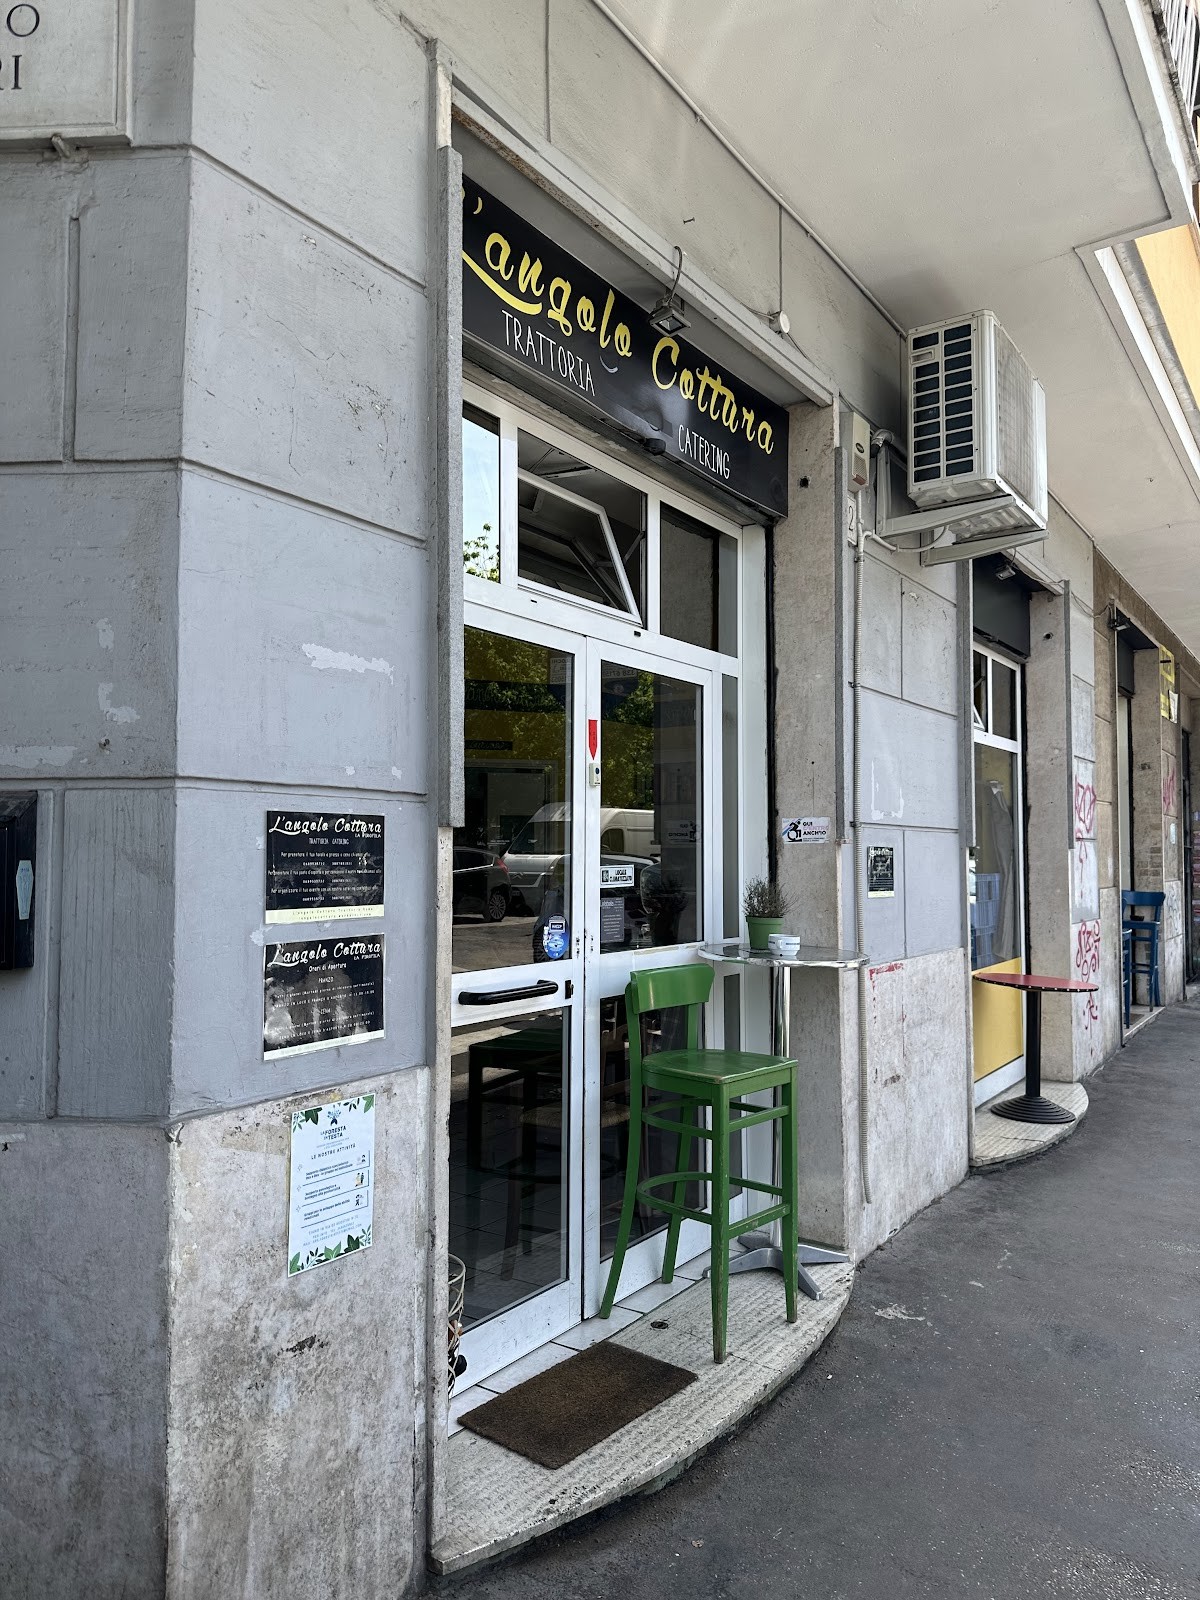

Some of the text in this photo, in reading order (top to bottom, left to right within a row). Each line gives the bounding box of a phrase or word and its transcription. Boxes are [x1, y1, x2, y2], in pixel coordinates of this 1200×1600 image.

[0, 55, 22, 90] I
[502, 309, 596, 397] TRATTORIA
[652, 337, 774, 454] Cottura
[678, 424, 731, 479] CATERING
[268, 816, 382, 835] L'angolo Cottura
[267, 942, 381, 967] L'angolo Cottura
[325, 1125, 346, 1136] FORESTA
[328, 1132, 343, 1140] TESTA
